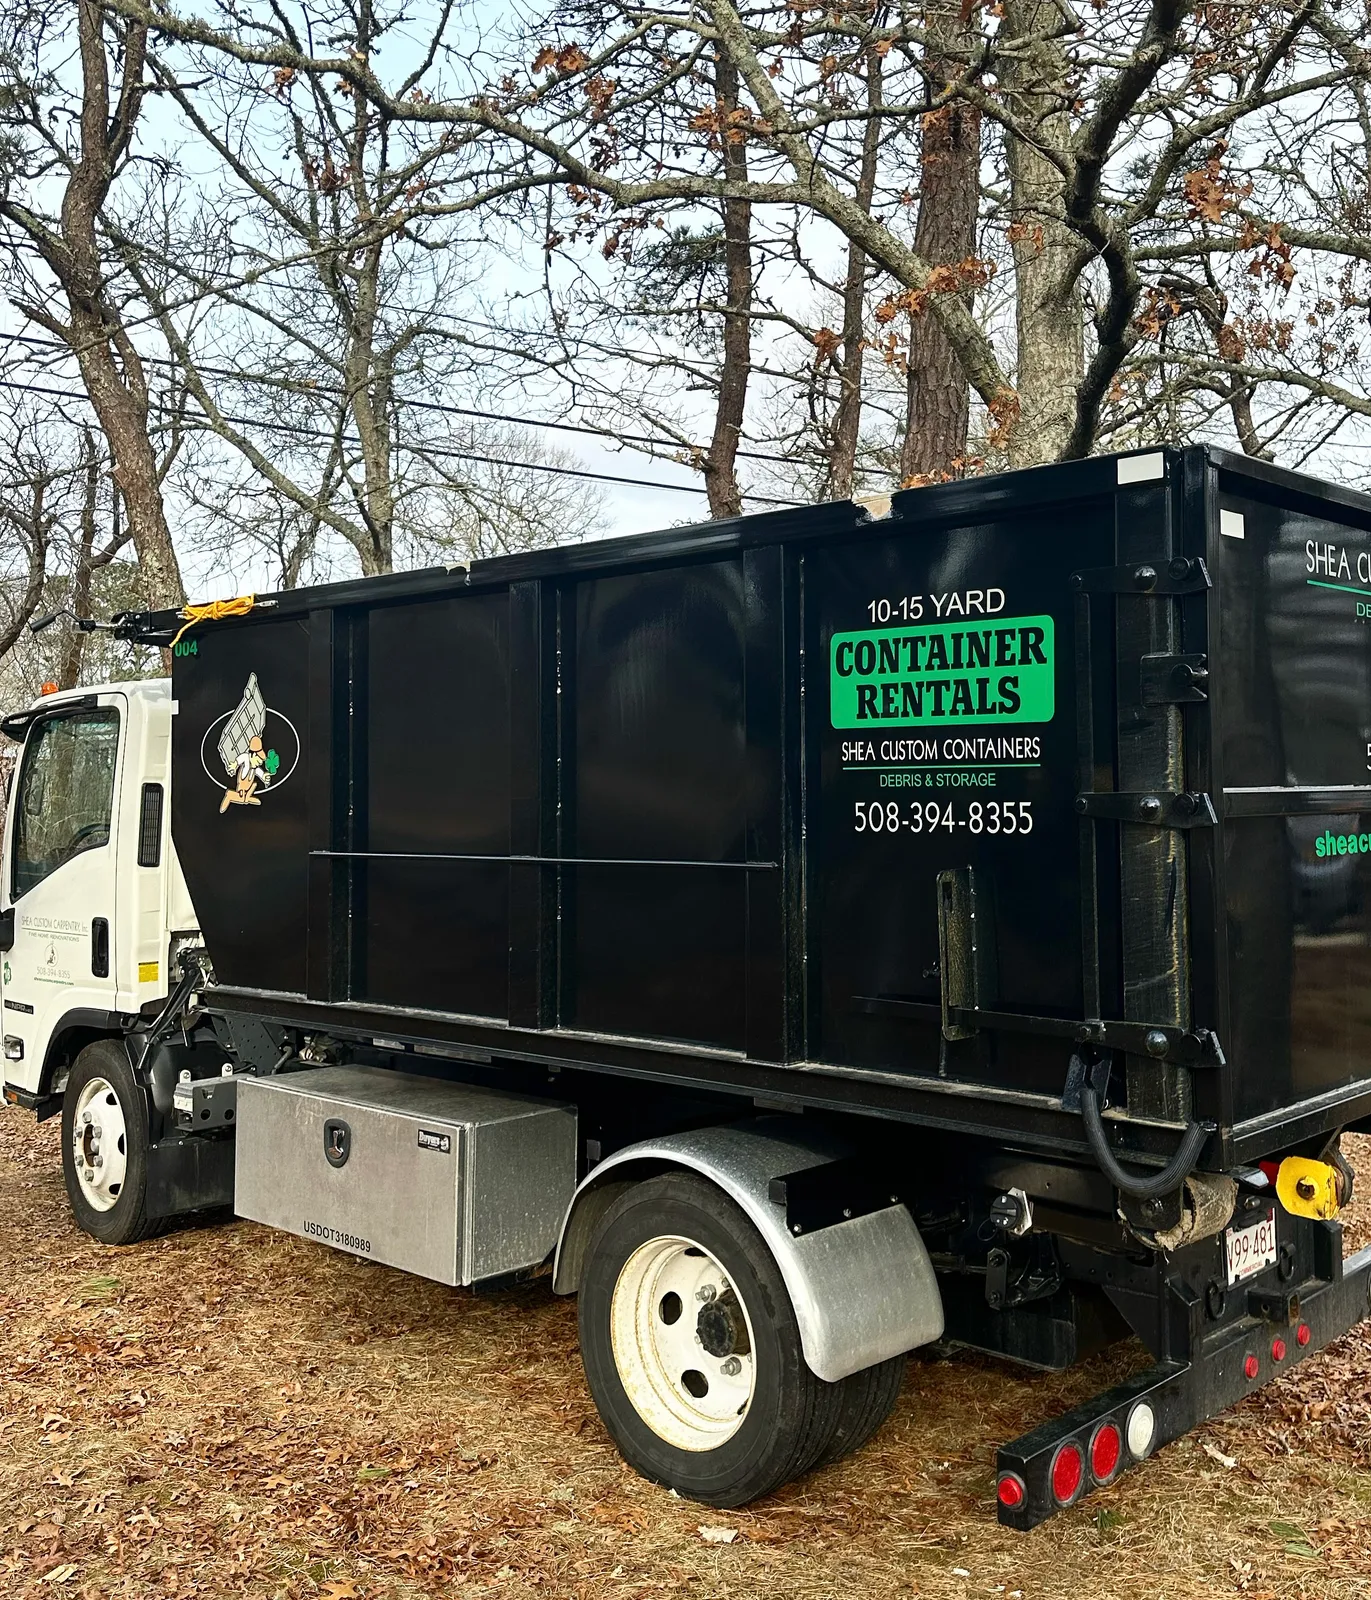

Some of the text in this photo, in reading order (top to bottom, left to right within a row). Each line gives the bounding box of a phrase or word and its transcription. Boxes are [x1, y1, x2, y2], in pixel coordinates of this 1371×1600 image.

[1306, 540, 1352, 580] SHEA
[867, 588, 1006, 623] 10-15 YARD
[175, 640, 198, 657] 004
[835, 626, 1047, 677] CONTAINER
[856, 675, 1021, 720] RENTALS
[841, 737, 1041, 761] SHEA CUSTOM CONTAINERS
[879, 772, 997, 787] DEBRIS & STORAGE
[854, 801, 1033, 834] 508-394-8355
[21, 915, 32, 926] SHEA
[33, 917, 53, 929] CUSTOM
[303, 1220, 371, 1252] USDOT3180989
